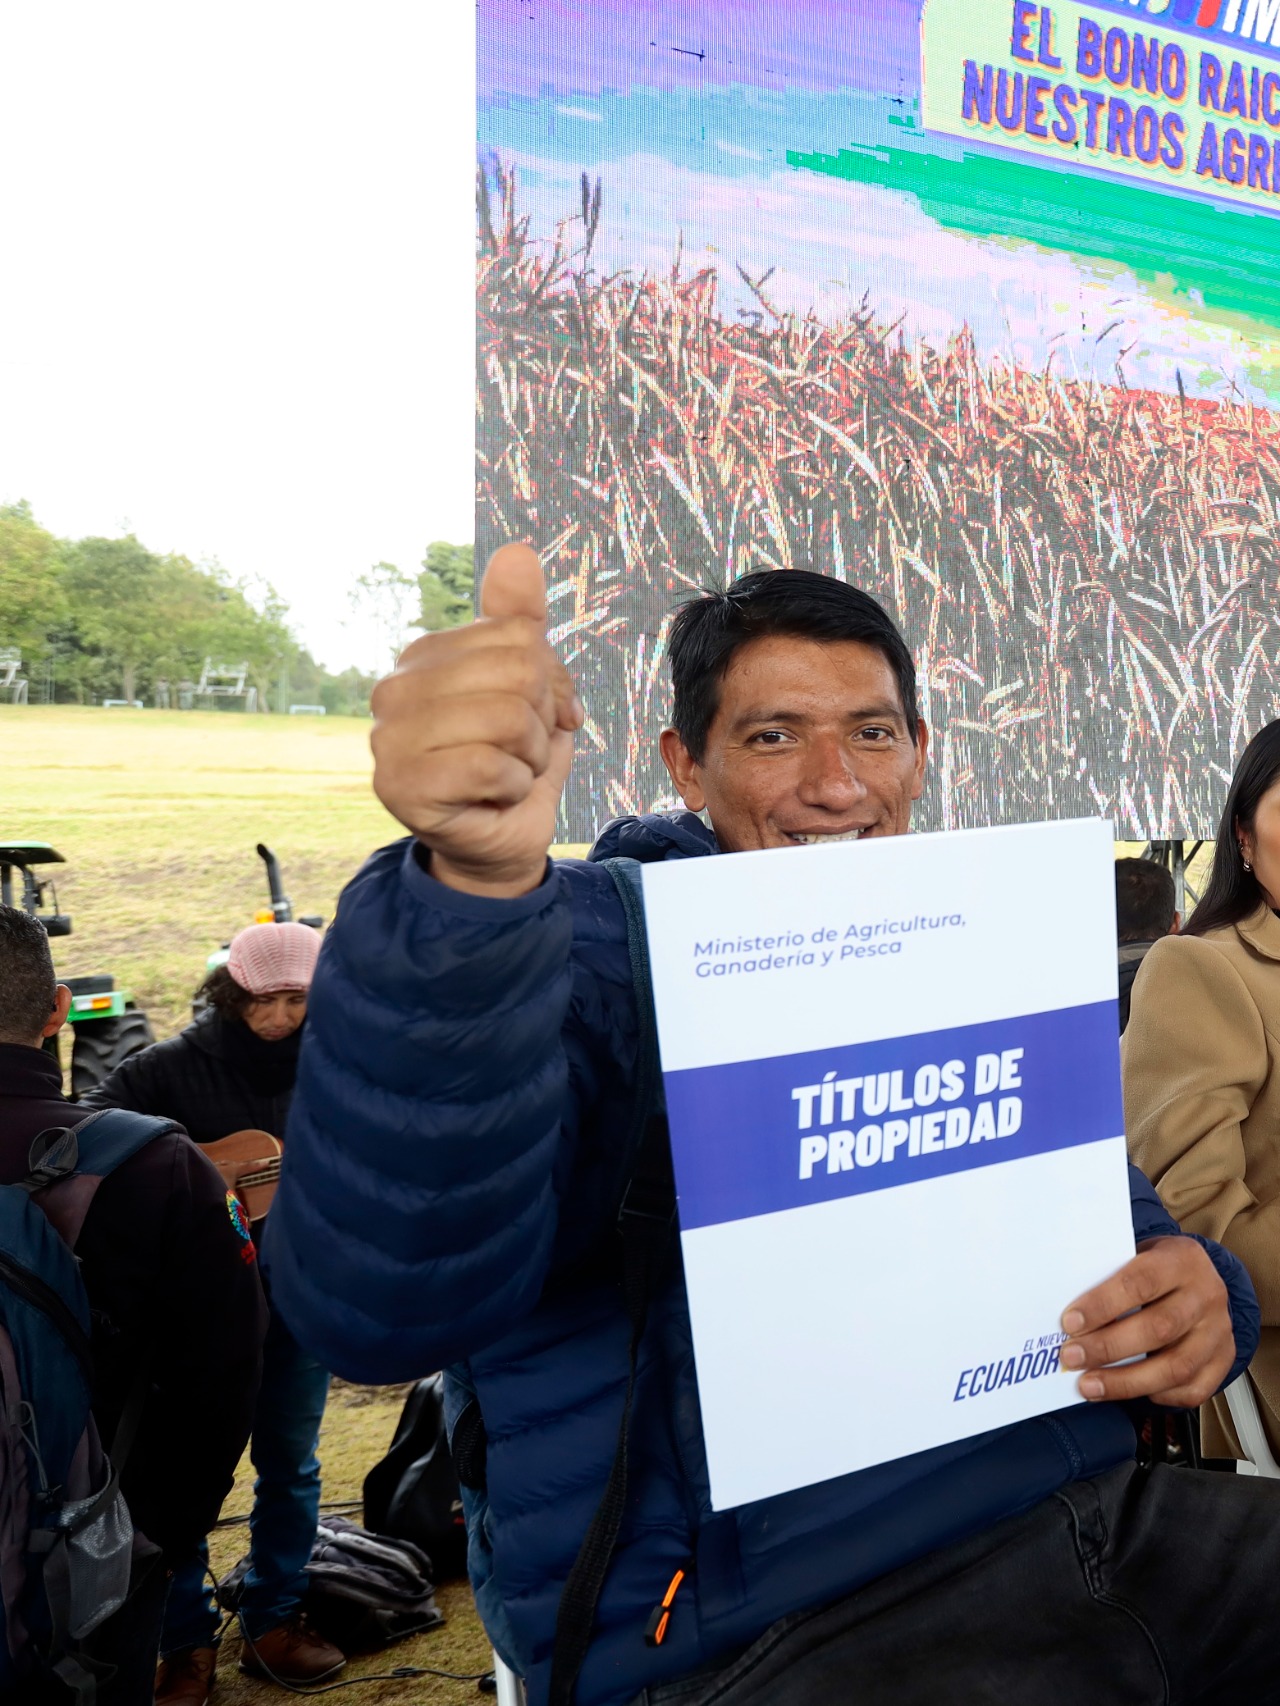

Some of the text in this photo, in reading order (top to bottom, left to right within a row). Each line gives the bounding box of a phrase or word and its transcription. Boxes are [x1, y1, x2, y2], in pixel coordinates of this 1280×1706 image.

[1011, 0, 1062, 67] EL
[1076, 17, 1186, 99] BONO
[962, 59, 1184, 169] NUESTROS
[693, 914, 967, 957] Ministerio de Agricultura,
[695, 941, 902, 978] Ganadería y Pesca
[792, 1047, 1024, 1130] TÍTULOS DE
[799, 1096, 1023, 1180] PROPIEDAD
[953, 1344, 1062, 1402] ECUADOR
[1023, 1338, 1035, 1352] EL
